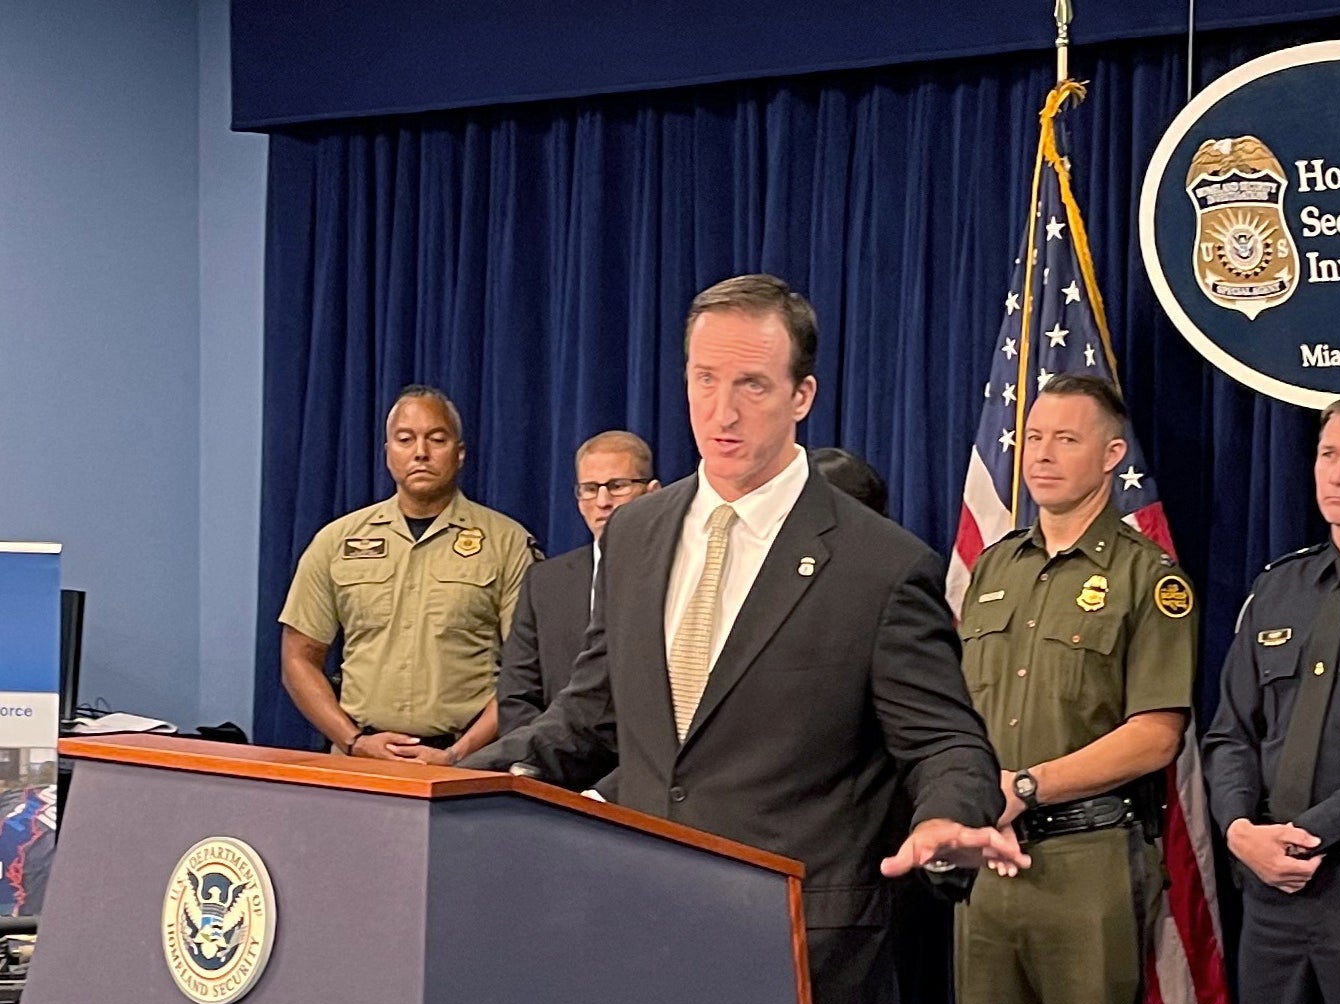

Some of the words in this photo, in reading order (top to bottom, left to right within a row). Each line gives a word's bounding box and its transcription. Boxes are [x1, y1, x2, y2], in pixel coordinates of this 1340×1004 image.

[1201, 242, 1215, 262] U
[1277, 238, 1289, 258] S
[0, 706, 33, 717] orce
[189, 846, 257, 891] DEPARTMENT
[253, 894, 263, 917] OF
[167, 922, 208, 996] HOMELAND
[212, 937, 259, 998] SECURITY
